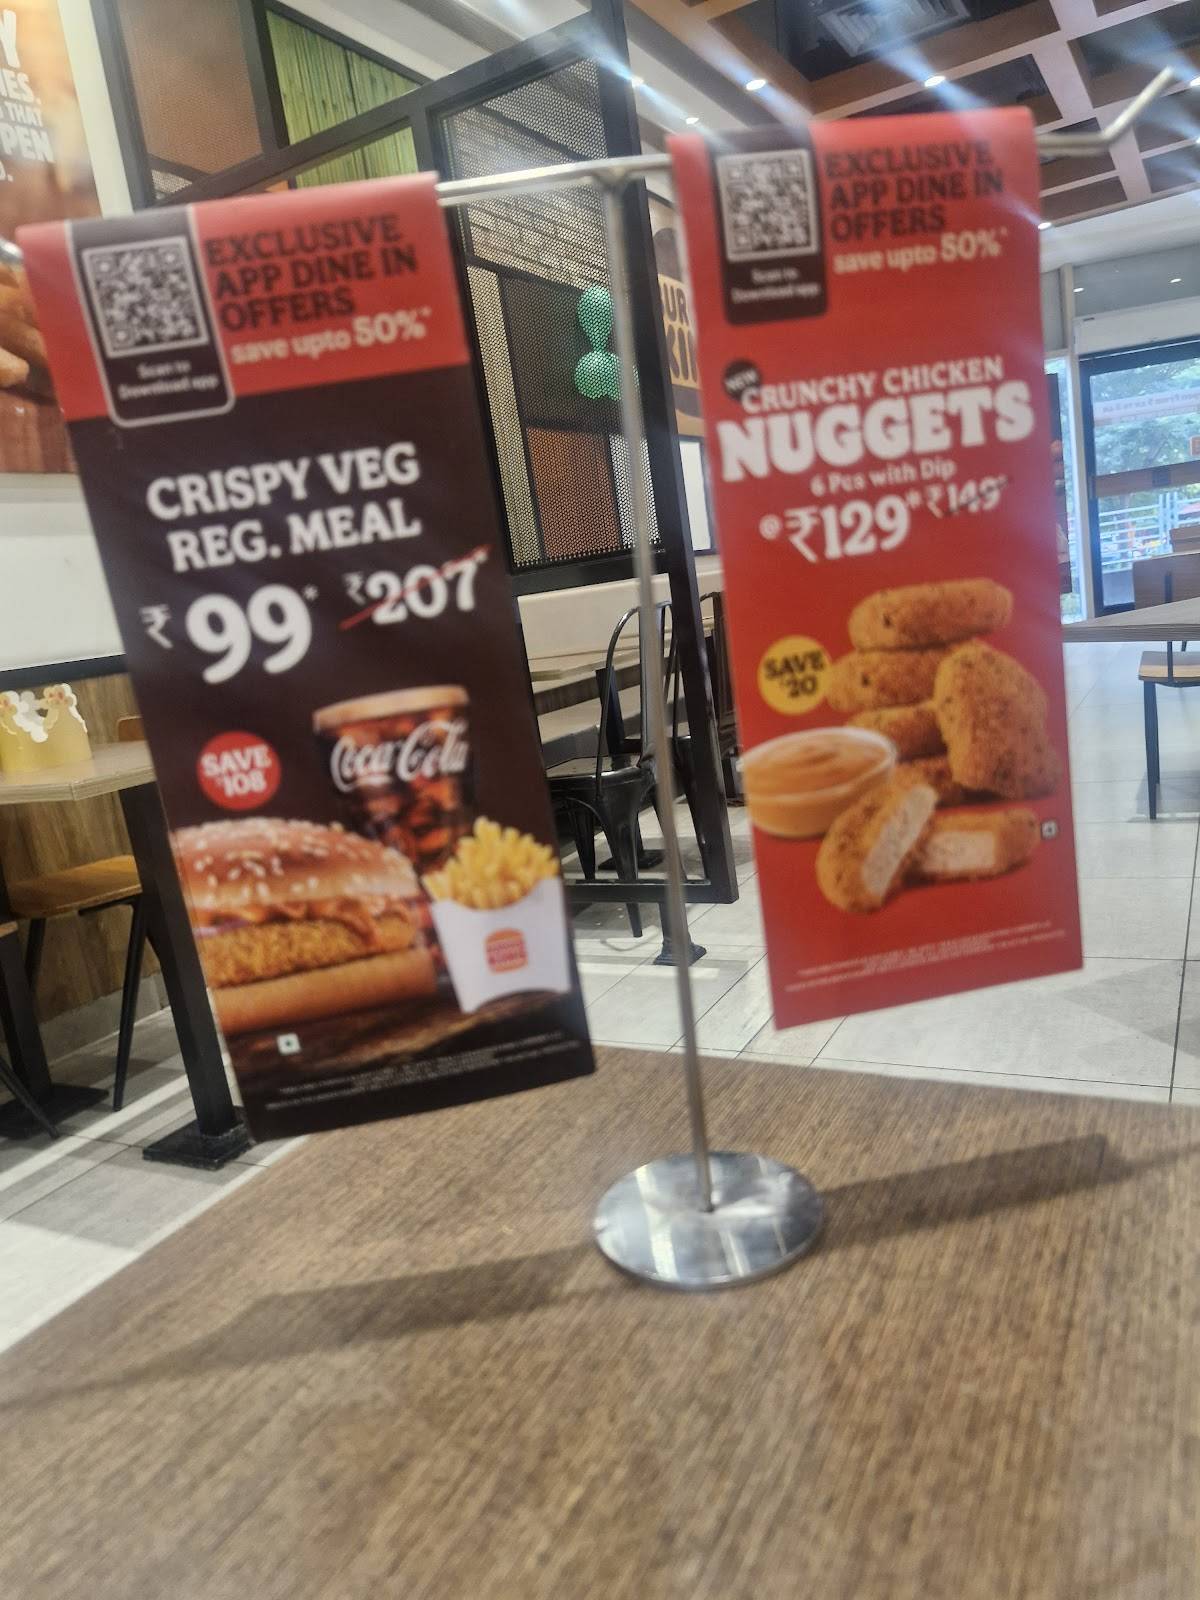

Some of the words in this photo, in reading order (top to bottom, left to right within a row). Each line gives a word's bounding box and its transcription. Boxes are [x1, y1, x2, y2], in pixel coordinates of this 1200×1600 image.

[823, 138, 993, 181] EXCLUSIVE
[831, 178, 889, 211] APP
[897, 170, 968, 206] DINE
[974, 167, 1005, 196] IN
[204, 213, 403, 267] EXCLUSIVE
[831, 203, 946, 243] OFFERS
[216, 263, 282, 300] APP
[290, 251, 374, 289] DINE
[380, 243, 418, 277] IN
[832, 251, 884, 276] save
[886, 244, 938, 273] upto
[219, 285, 356, 332] OFFERS
[229, 337, 290, 366] save
[290, 328, 351, 361] upto
[741, 371, 877, 415] CRUNCHY
[882, 354, 1004, 396] CHICKEN
[716, 379, 1035, 483] NUGGETS
[145, 457, 312, 521] CRISPY
[317, 441, 421, 495] VEG
[809, 474, 826, 498] 6
[868, 462, 918, 488] with
[919, 455, 957, 481] Dip
[165, 518, 283, 574] REG.
[286, 497, 424, 555] MEAL
[763, 651, 825, 681] SAVE
[780, 675, 819, 699] 20
[200, 742, 273, 778] SAVE
[215, 767, 268, 799] 108
